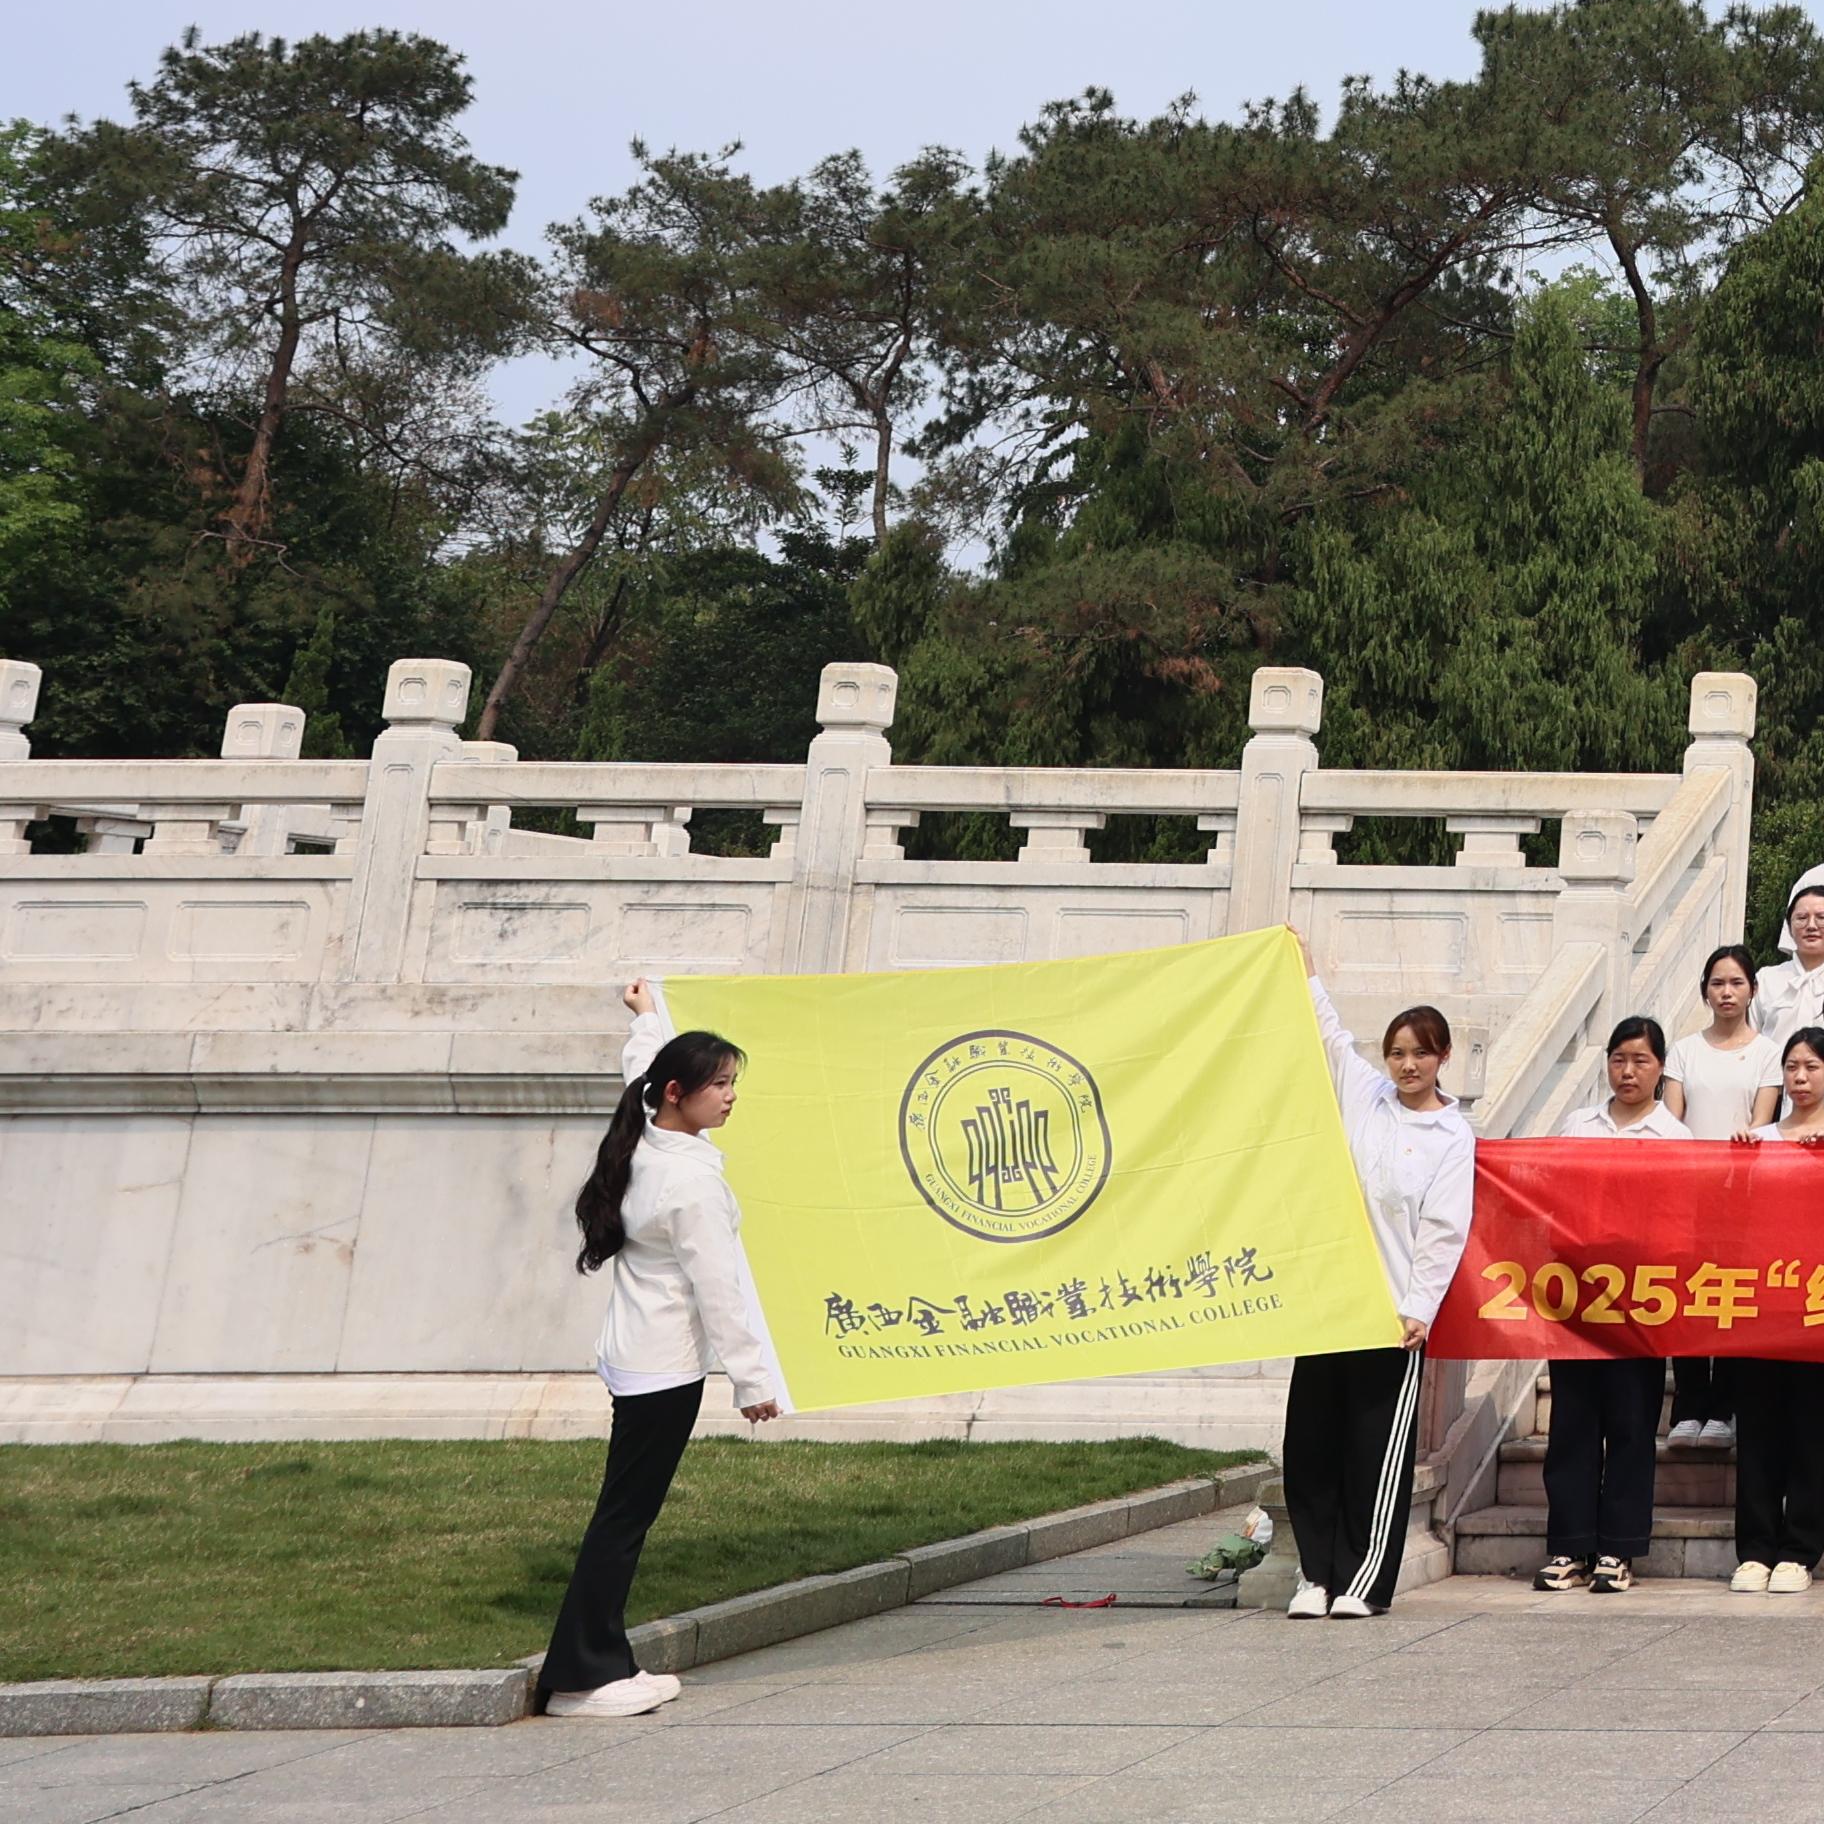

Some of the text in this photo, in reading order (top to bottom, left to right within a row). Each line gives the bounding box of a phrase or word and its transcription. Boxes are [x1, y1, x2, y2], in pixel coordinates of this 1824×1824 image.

[925, 1153, 1098, 1233] GUANGXI FINANCIAL VOCATIONAL COLLEGE
[838, 1293, 1284, 1360] GUANGXI FINANCIAL VOCATIONAL COLLEGE
